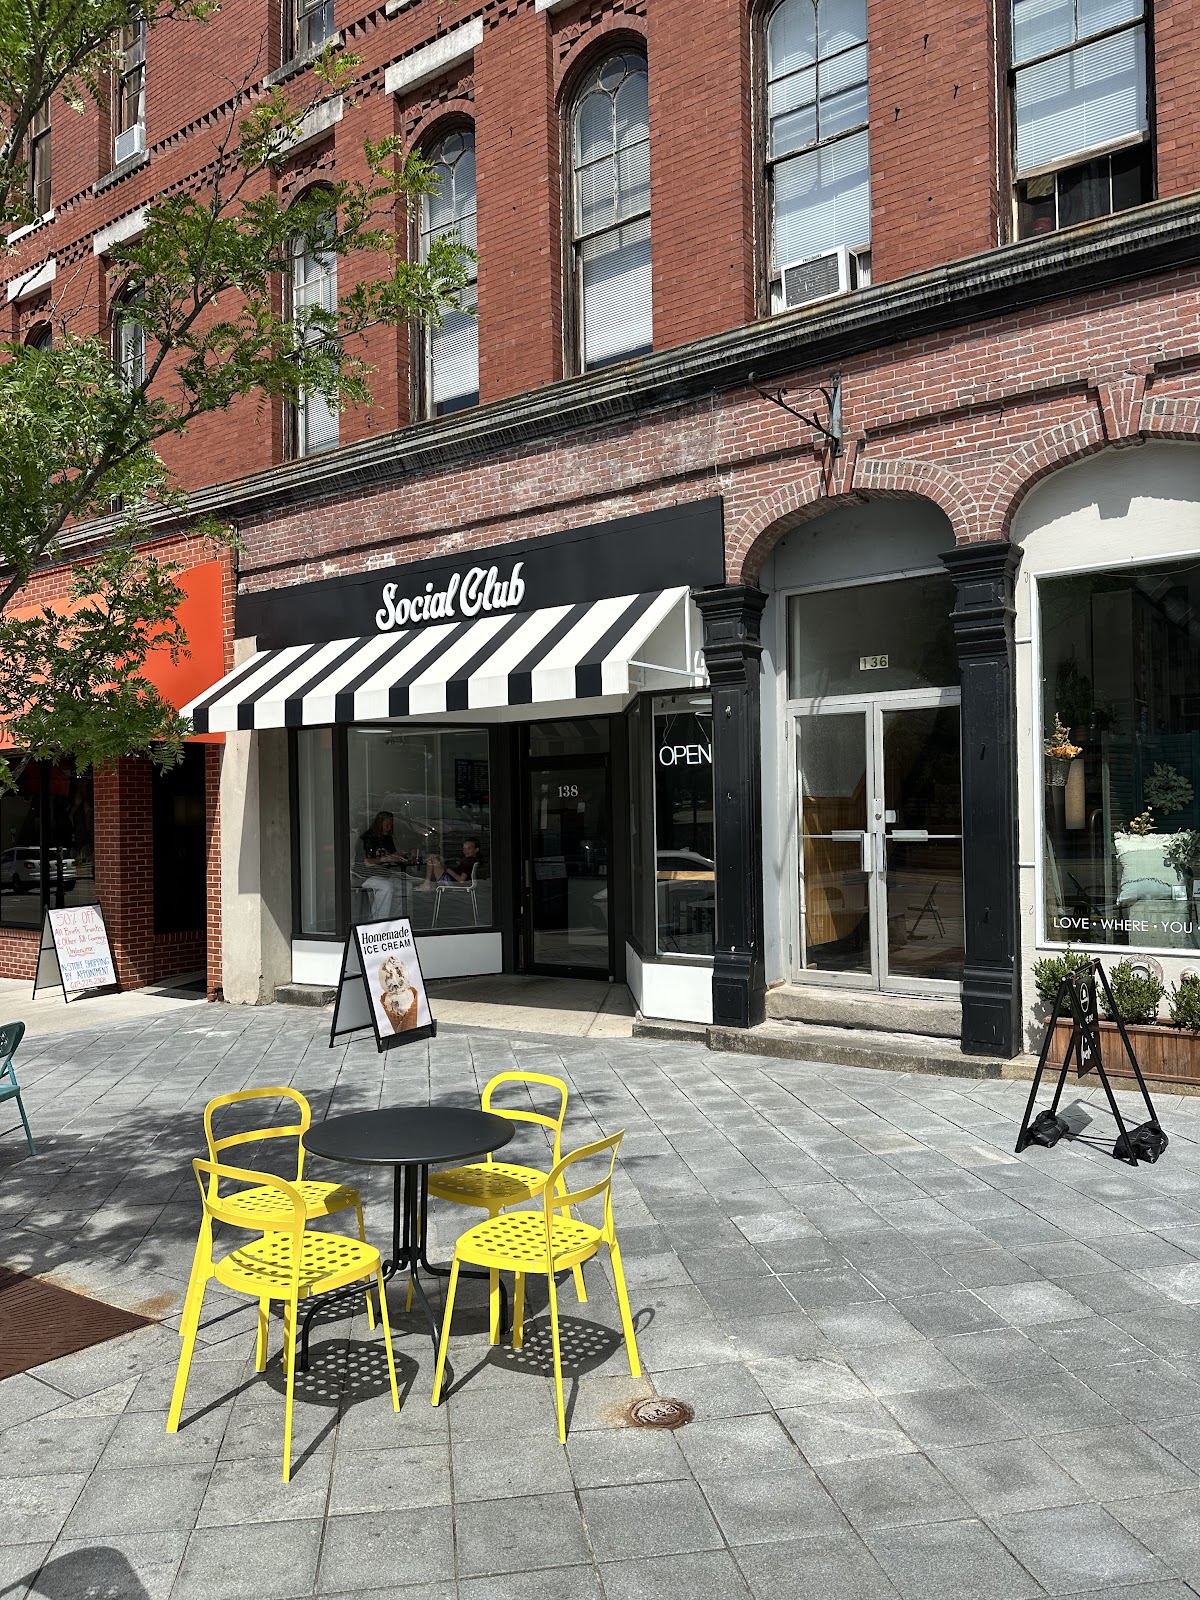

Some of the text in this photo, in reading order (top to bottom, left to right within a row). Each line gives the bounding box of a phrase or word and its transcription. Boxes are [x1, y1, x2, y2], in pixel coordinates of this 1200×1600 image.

[376, 562, 526, 631] Social Club
[862, 656, 888, 669] 136
[659, 744, 712, 766] OPEN
[558, 784, 579, 798] 138
[82, 910, 94, 924] OFF
[1053, 916, 1193, 934] LOVE WHERE YOU
[362, 926, 409, 945] Homemade
[363, 938, 411, 955] ICE CREAM
[65, 972, 73, 981] BY
